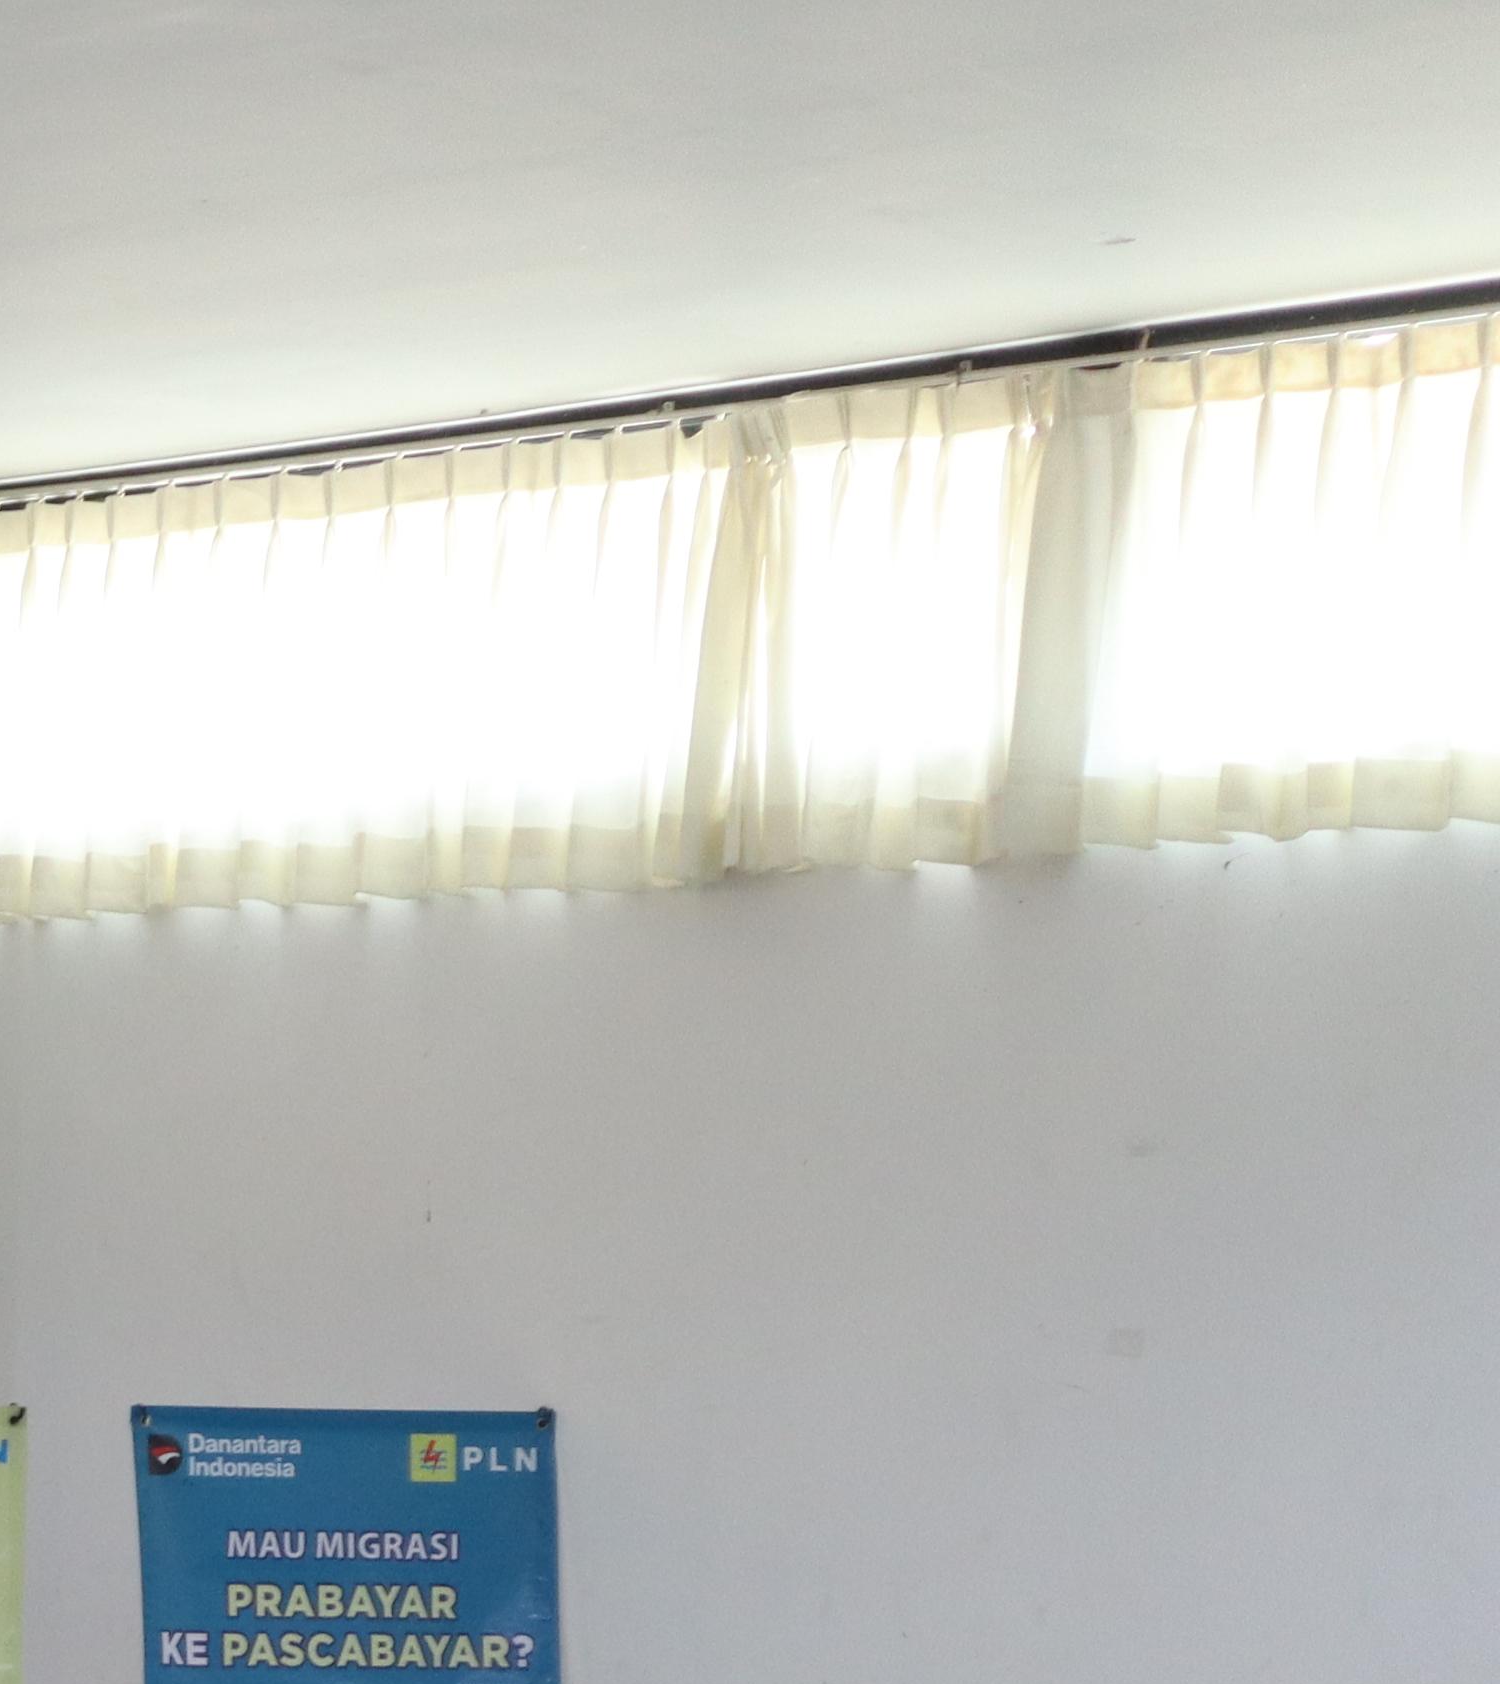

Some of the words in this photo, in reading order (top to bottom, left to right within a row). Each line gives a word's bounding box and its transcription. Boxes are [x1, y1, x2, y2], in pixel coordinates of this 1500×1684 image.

[188, 1433, 301, 1455] Danantara
[463, 1445, 538, 1472] PLN
[188, 1456, 296, 1478] Indonesia
[227, 1530, 306, 1559] MAU
[316, 1531, 460, 1561] MIGRASI
[227, 1583, 458, 1619] PRABAYAR
[161, 1631, 209, 1666] KE
[222, 1632, 536, 1670] PASCABAYAR?
